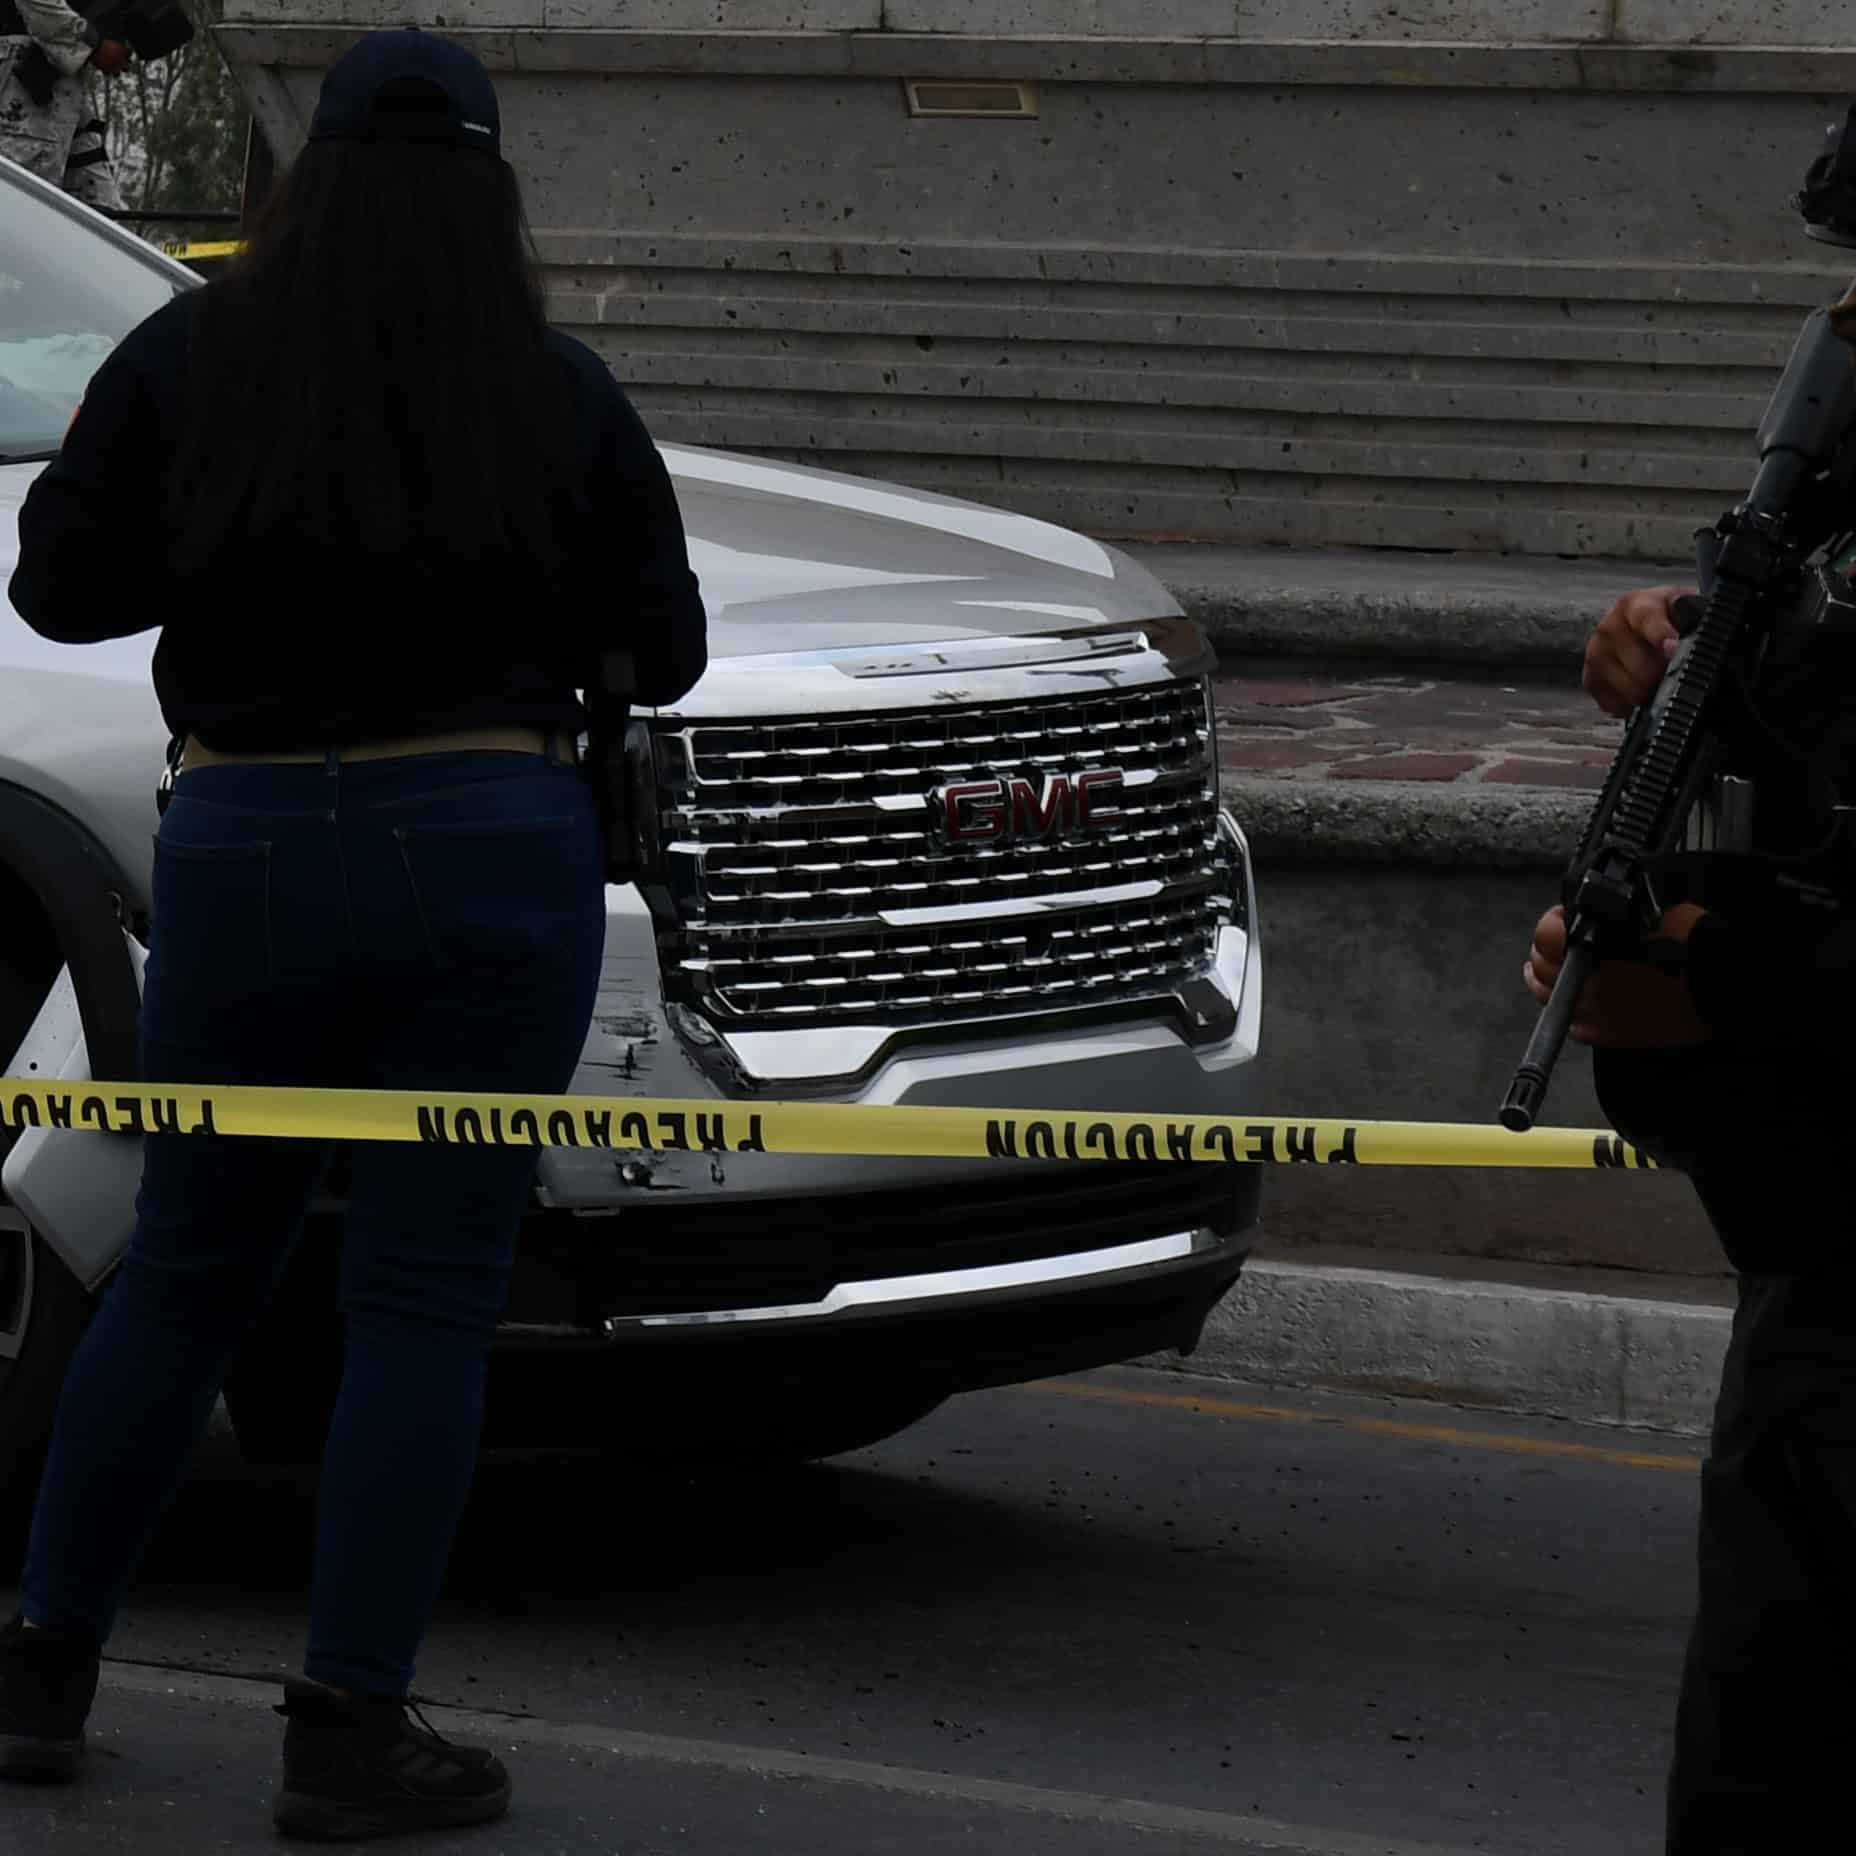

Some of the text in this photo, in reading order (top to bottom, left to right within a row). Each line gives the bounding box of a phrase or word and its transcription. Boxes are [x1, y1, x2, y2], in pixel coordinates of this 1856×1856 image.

[943, 766, 1124, 842] GMC
[417, 1106, 768, 1153] PRECAUCION
[985, 1119, 1359, 1164] PRECAUCION
